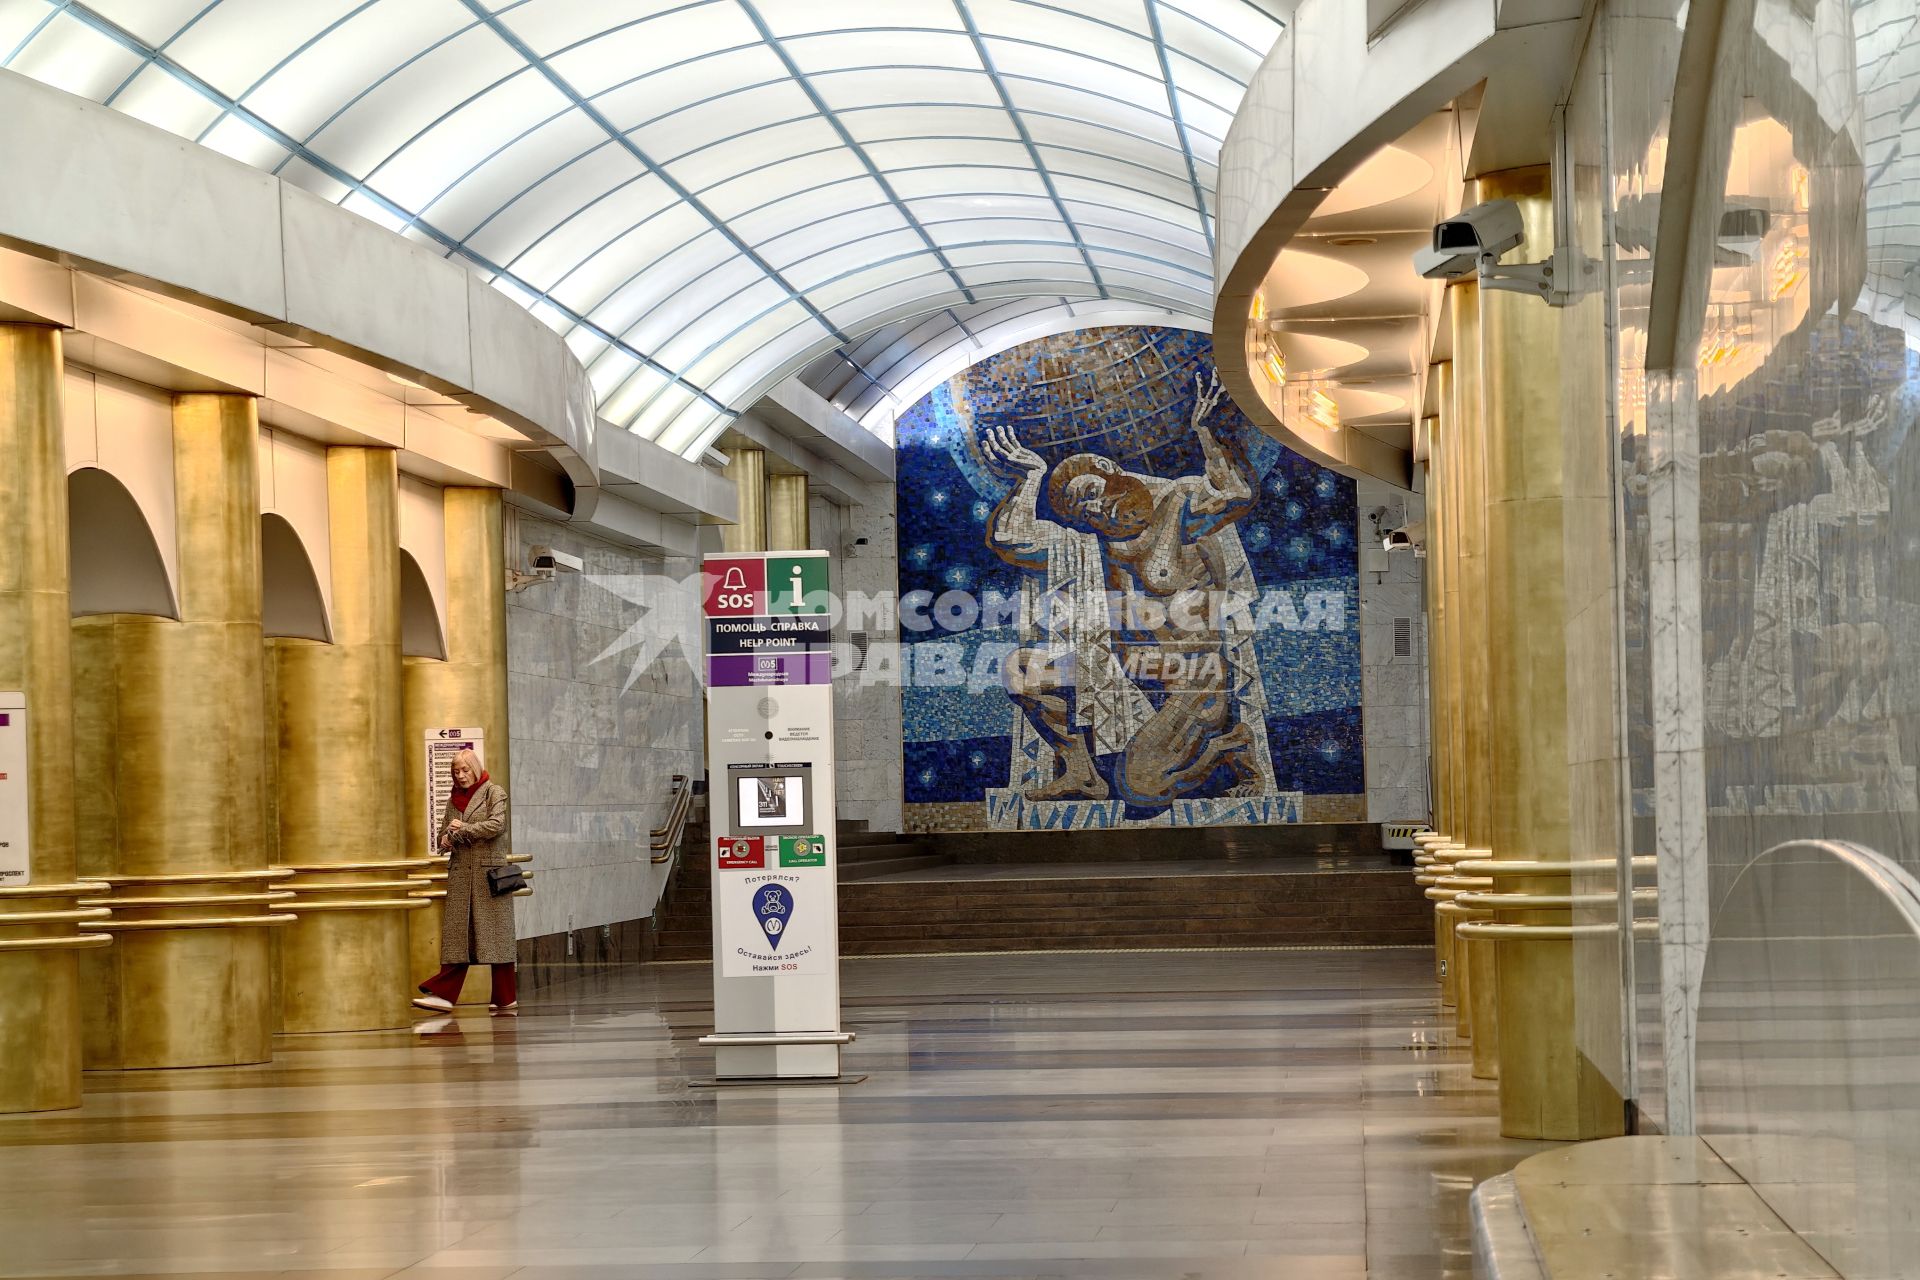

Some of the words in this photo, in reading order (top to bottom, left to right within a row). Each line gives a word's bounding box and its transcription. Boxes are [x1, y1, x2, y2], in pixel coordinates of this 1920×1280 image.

[717, 593, 754, 609] SOS
[716, 623, 767, 633] ПОМОЩЬ
[770, 621, 819, 632] СПРАВКА
[739, 638, 764, 648] HELP
[766, 637, 797, 647] POINT
[744, 874, 800, 884] Потерялся?
[737, 947, 783, 961] Оставайся
[785, 945, 812, 960] здесь!
[752, 964, 779, 972] Нажми
[781, 963, 798, 971] SOS
